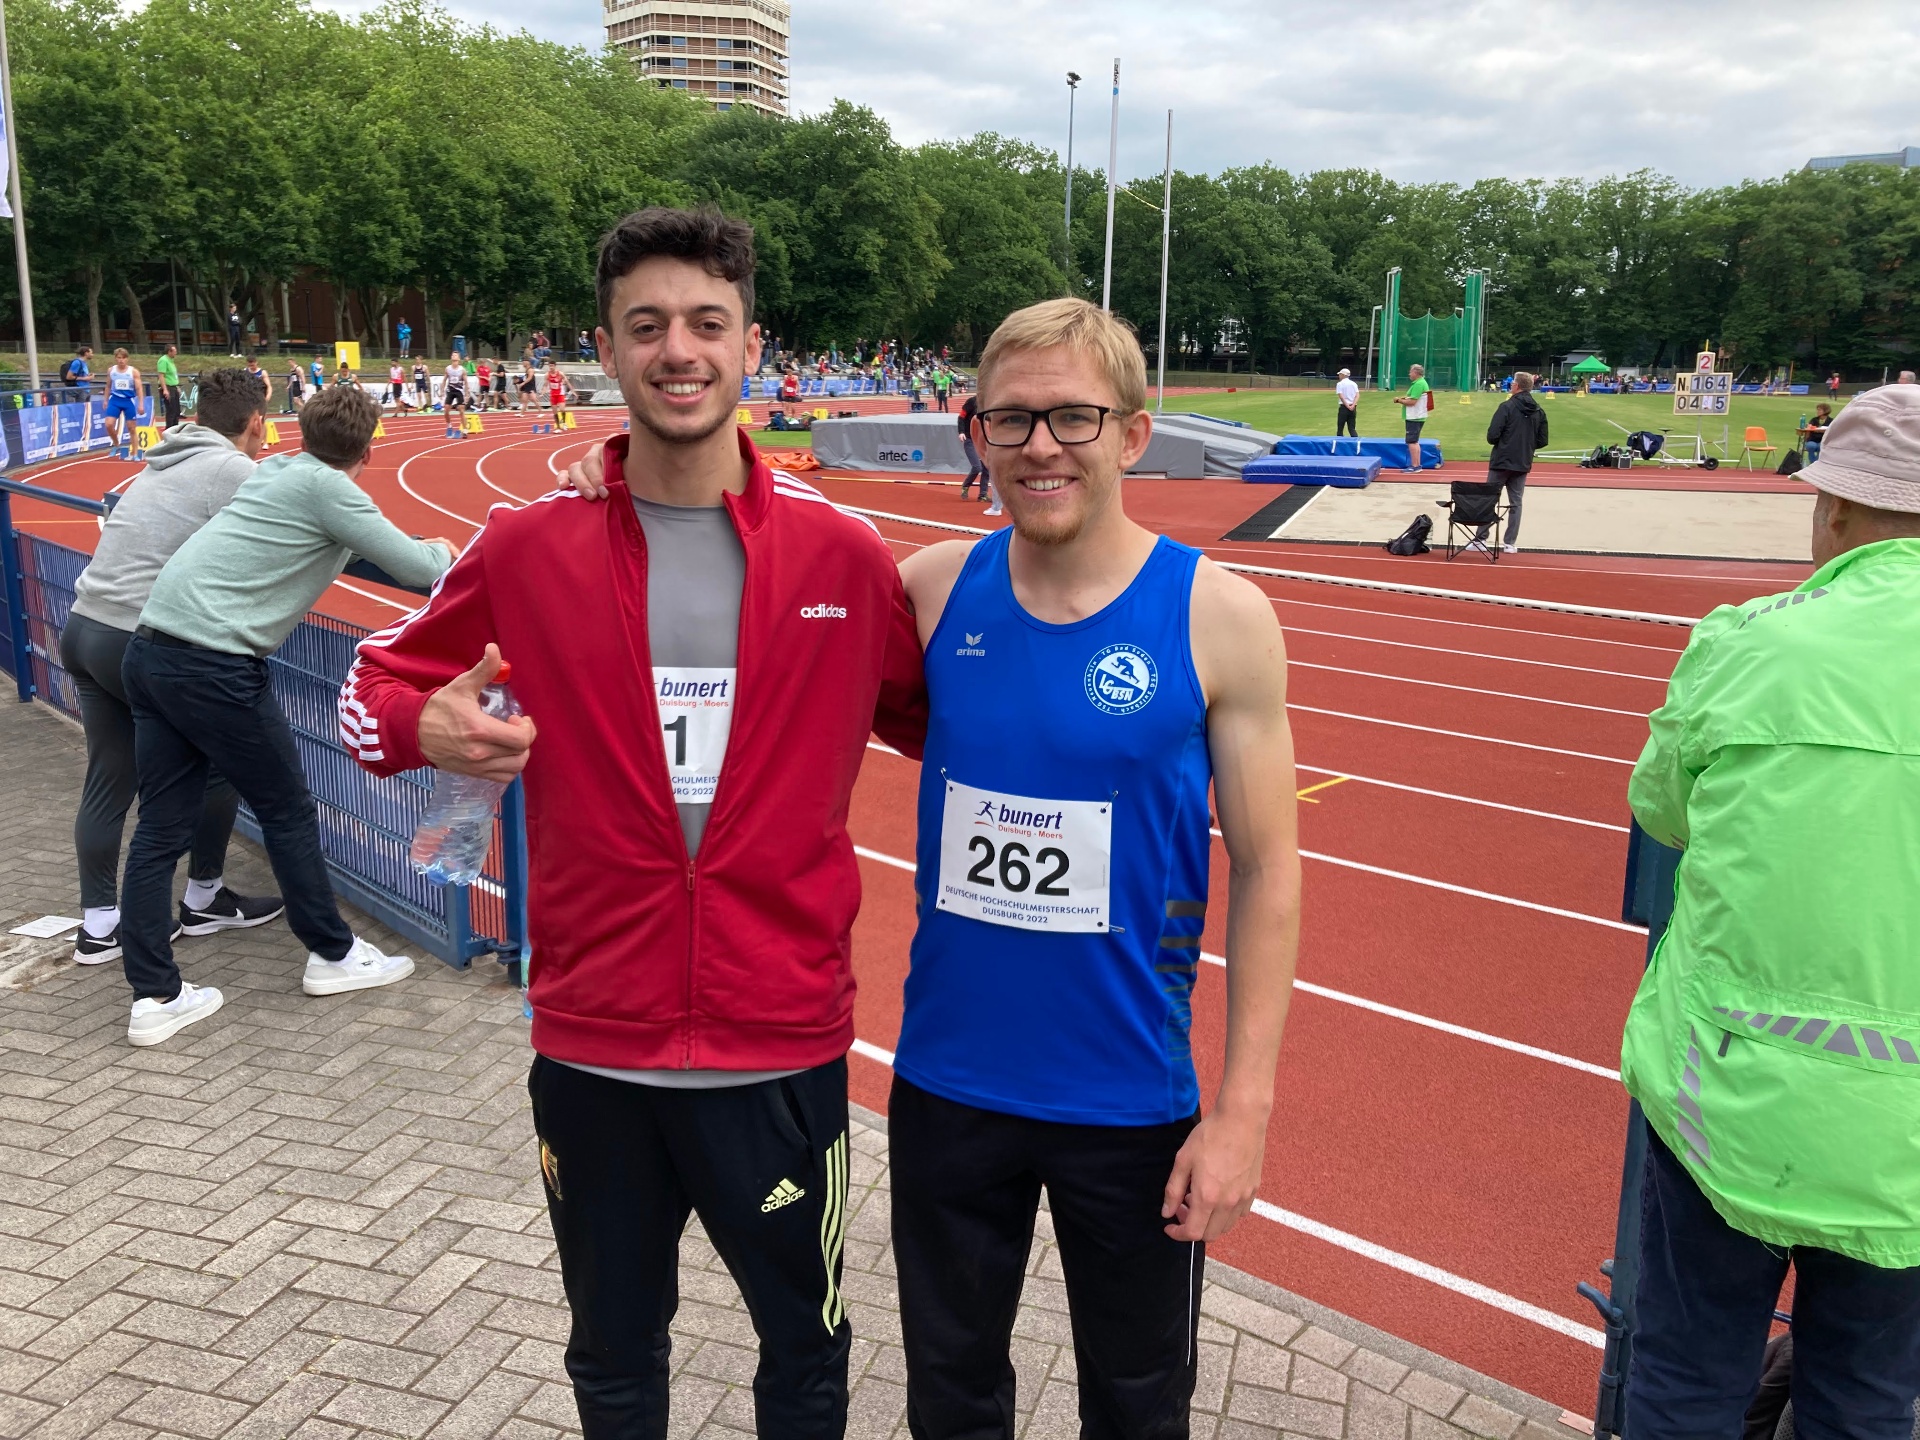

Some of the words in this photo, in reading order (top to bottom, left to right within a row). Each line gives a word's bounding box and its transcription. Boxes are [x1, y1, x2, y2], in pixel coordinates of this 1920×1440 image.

[1701, 355, 1711, 370] 2
[1693, 376, 1727, 390] 164
[138, 431, 147, 448] 8
[879, 450, 908, 461] artec
[800, 603, 847, 618] adidas
[956, 647, 986, 657] erima
[659, 678, 728, 698] bunert
[659, 699, 697, 708] Duisburg
[704, 699, 729, 708] Moers
[664, 715, 687, 766] 1
[691, 787, 714, 795] 2022
[998, 804, 1063, 830] bunert
[998, 824, 1032, 838] Duisburg
[1038, 830, 1063, 840] Moers
[967, 835, 1070, 897] 262
[945, 885, 978, 901] DEUTSCHE
[979, 894, 1100, 915] HOCHSCHULMEISTERSCHAFT
[982, 906, 1024, 921] DUISBURG
[1026, 914, 1048, 924] 2022
[761, 1188, 805, 1213] adidas
